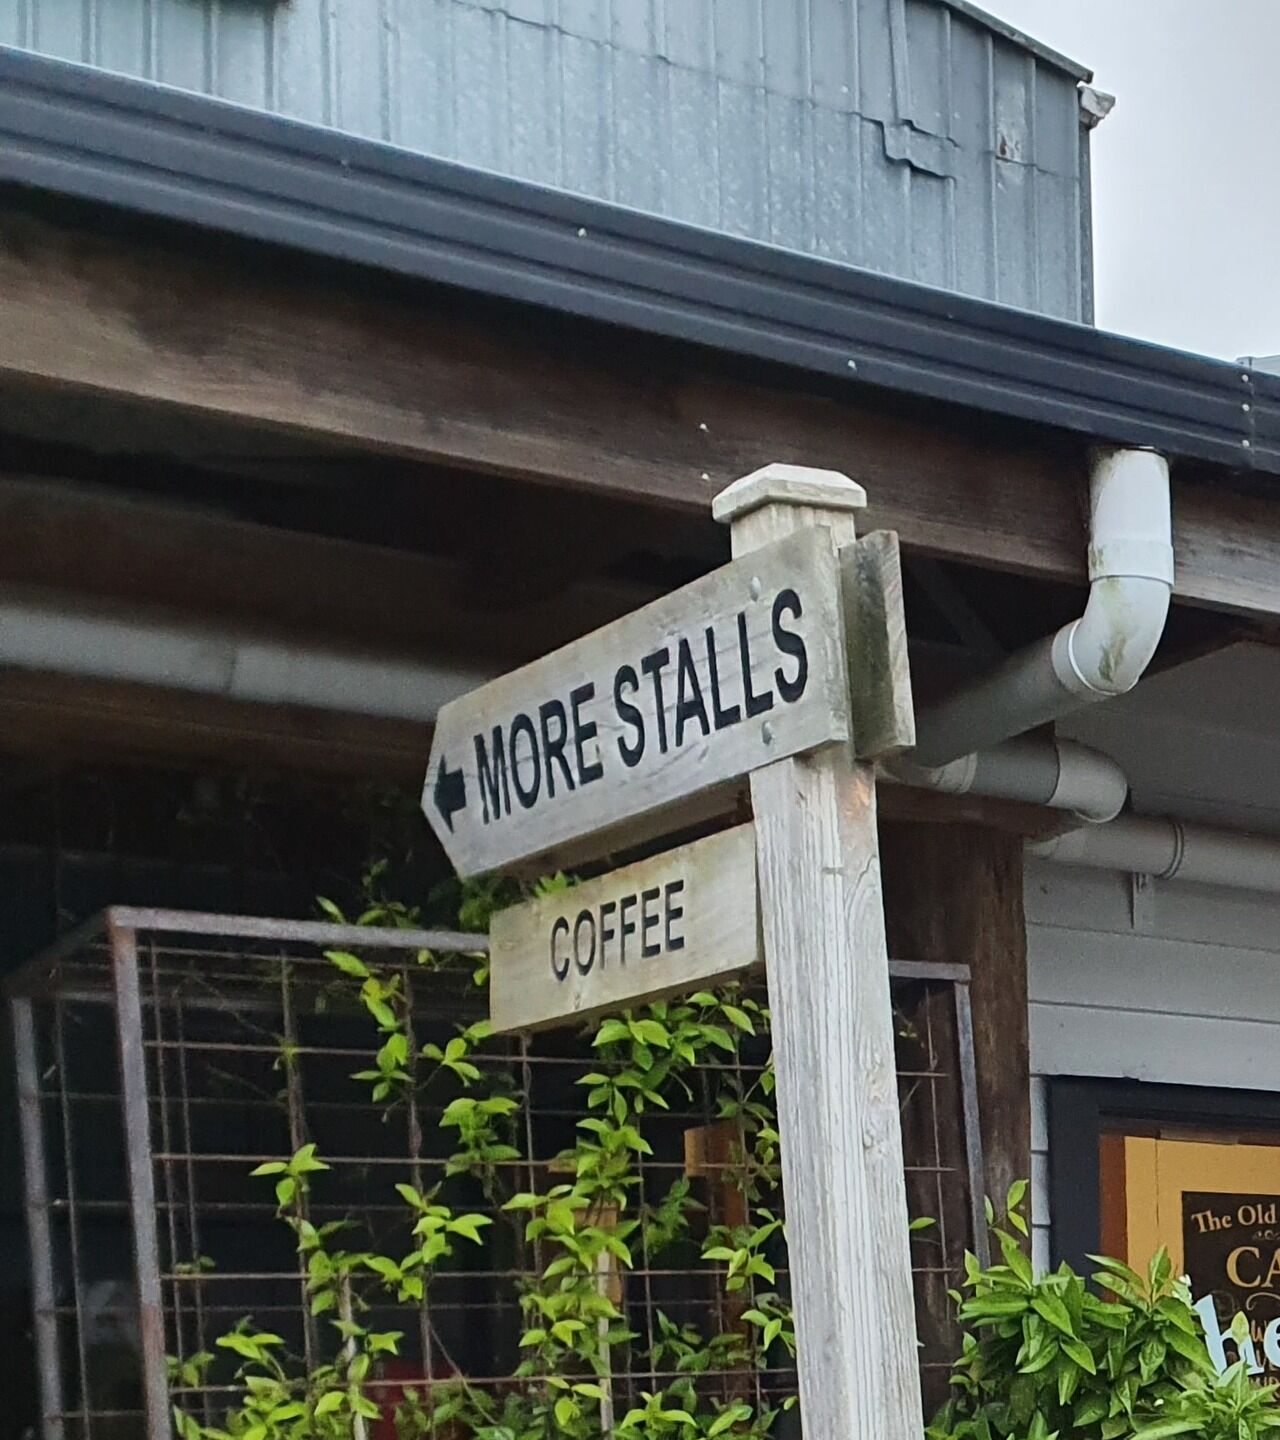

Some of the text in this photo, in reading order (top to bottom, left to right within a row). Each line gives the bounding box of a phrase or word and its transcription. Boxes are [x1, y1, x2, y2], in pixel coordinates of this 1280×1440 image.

[474, 588, 809, 825] MORE STALLS
[550, 879, 686, 982] COFFEE
[1191, 1207, 1232, 1234] The
[1237, 1203, 1277, 1226] Old
